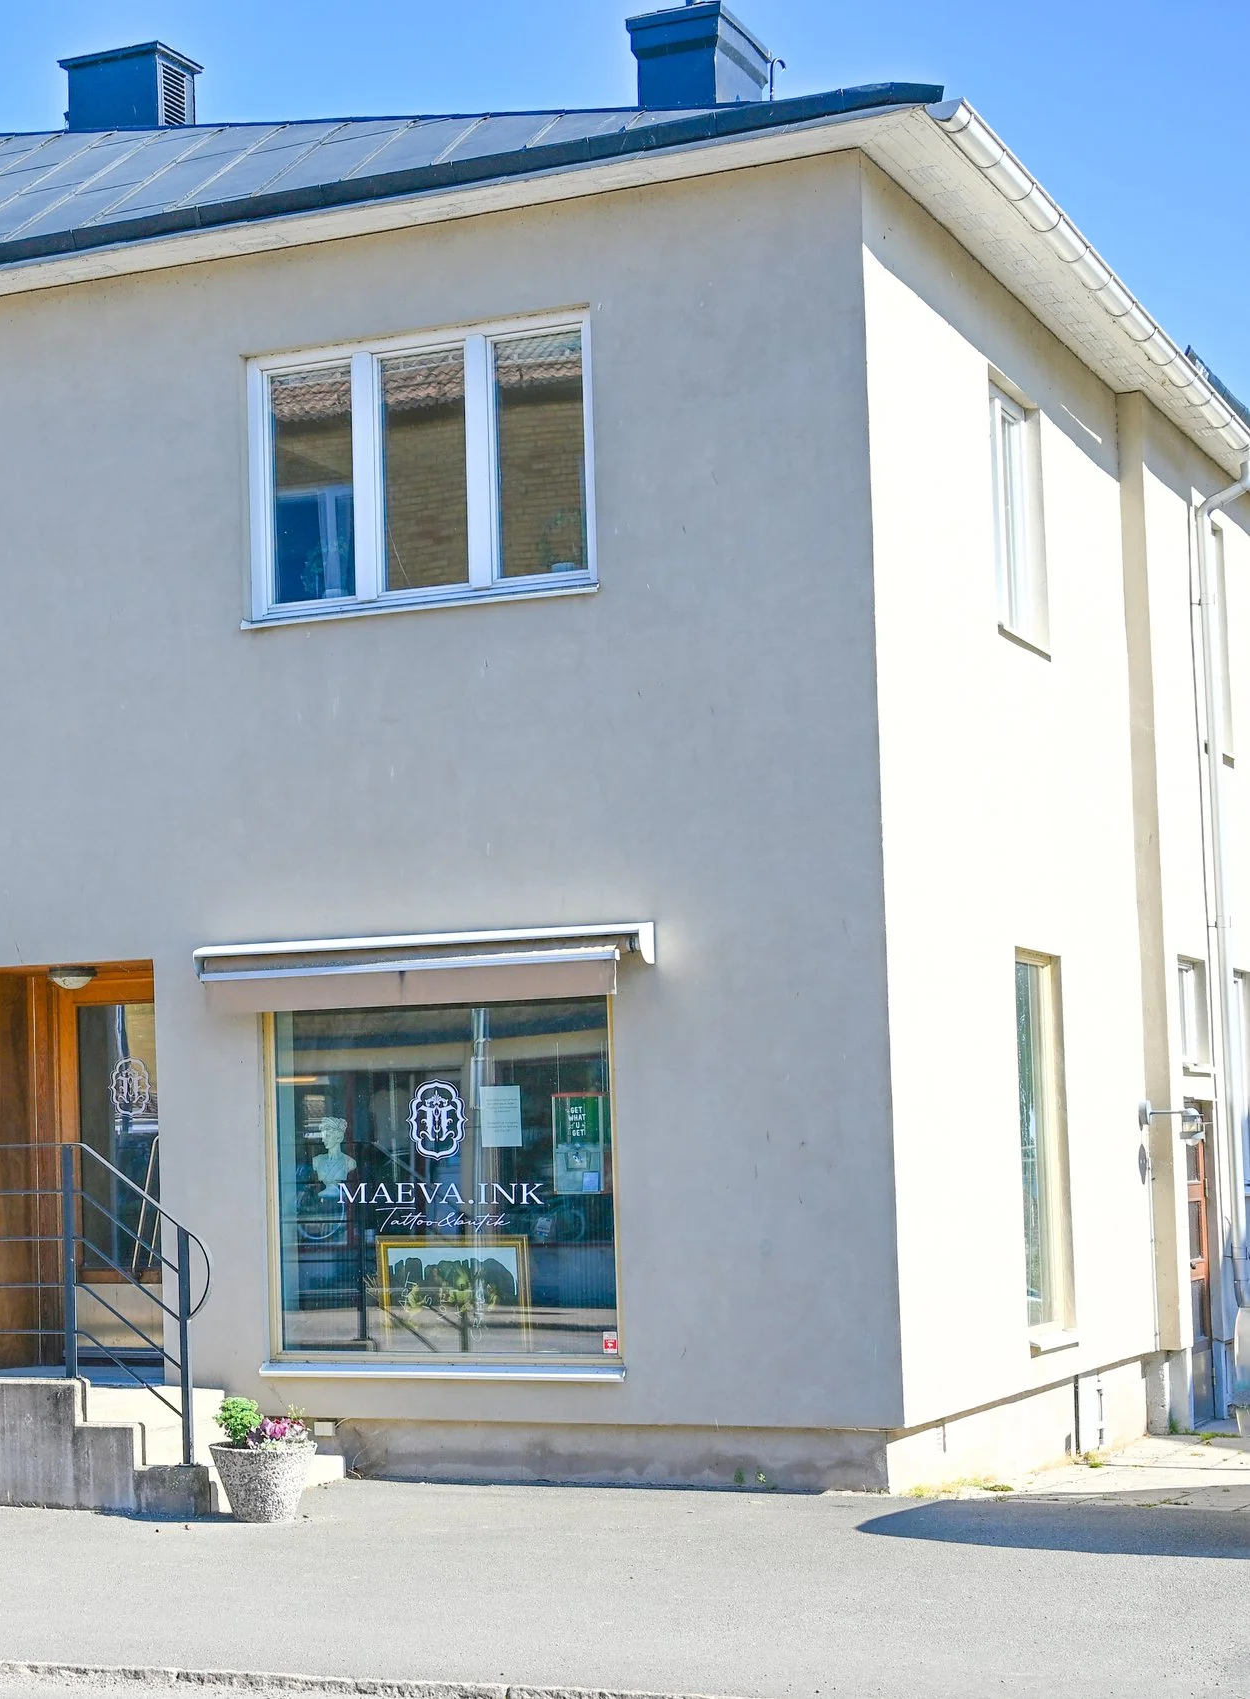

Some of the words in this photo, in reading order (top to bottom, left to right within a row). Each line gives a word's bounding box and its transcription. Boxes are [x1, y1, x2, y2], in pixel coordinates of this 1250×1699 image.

[570, 1106, 583, 1114] GET
[568, 1113, 586, 1122] WHAT
[337, 1182, 545, 1205] MAEVA.INK
